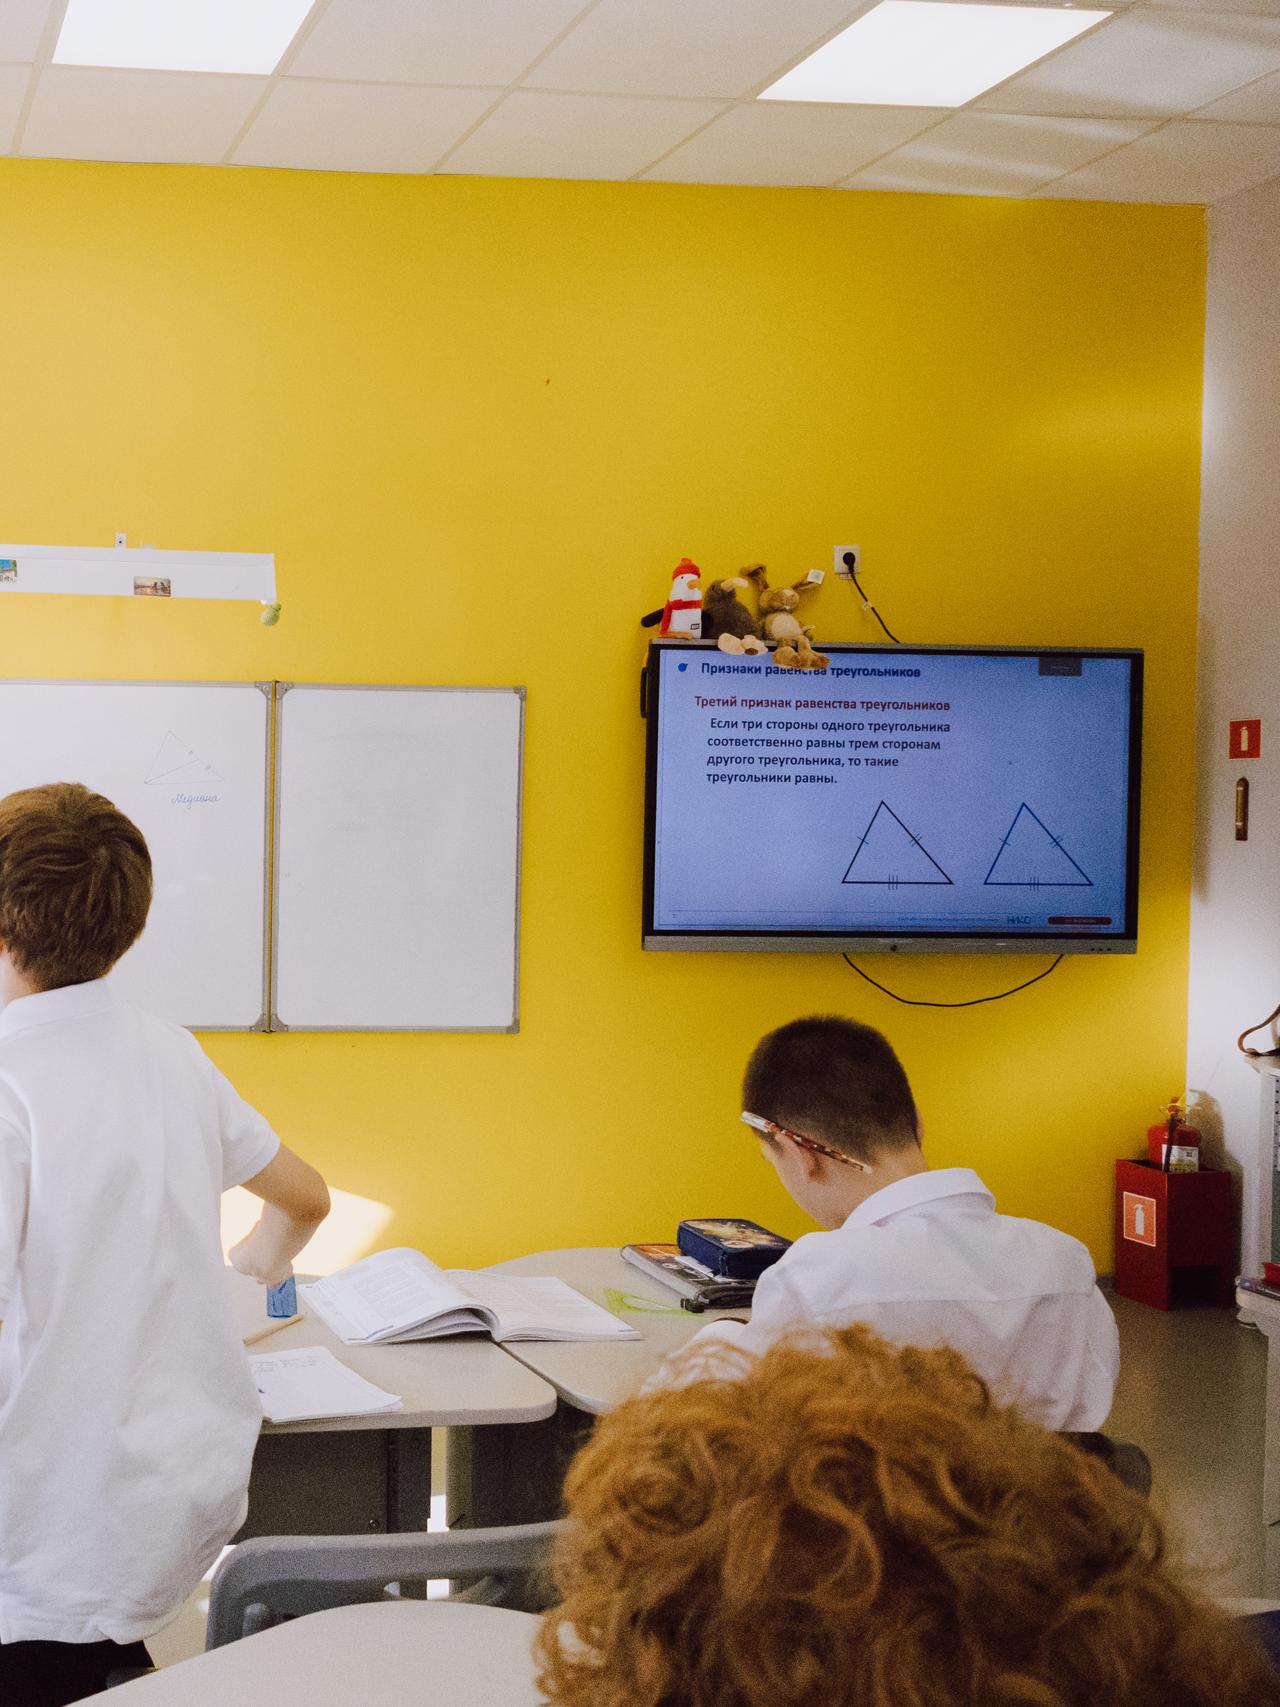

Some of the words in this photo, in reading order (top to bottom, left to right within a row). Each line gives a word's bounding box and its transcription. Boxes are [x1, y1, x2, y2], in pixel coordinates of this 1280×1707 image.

[701, 663, 761, 676] Признаки
[830, 667, 921, 678] треугольников
[694, 696, 737, 709] Третий
[741, 699, 792, 710] признак
[795, 699, 857, 711] равенства
[860, 701, 951, 712] треугольников
[710, 718, 738, 729] Если
[742, 720, 763, 731] три
[766, 720, 818, 732] стороны
[821, 722, 865, 732] одного
[868, 722, 951, 733] треугольника
[707, 738, 803, 747] соответственно
[806, 739, 845, 750] равны
[849, 740, 879, 751] трем
[882, 740, 941, 751] сторонам
[706, 756, 755, 767] другого
[758, 757, 845, 767] треугольника,
[848, 758, 861, 766] то
[865, 758, 899, 767] такие
[706, 773, 791, 785] треугольники
[795, 775, 838, 786] равны.
